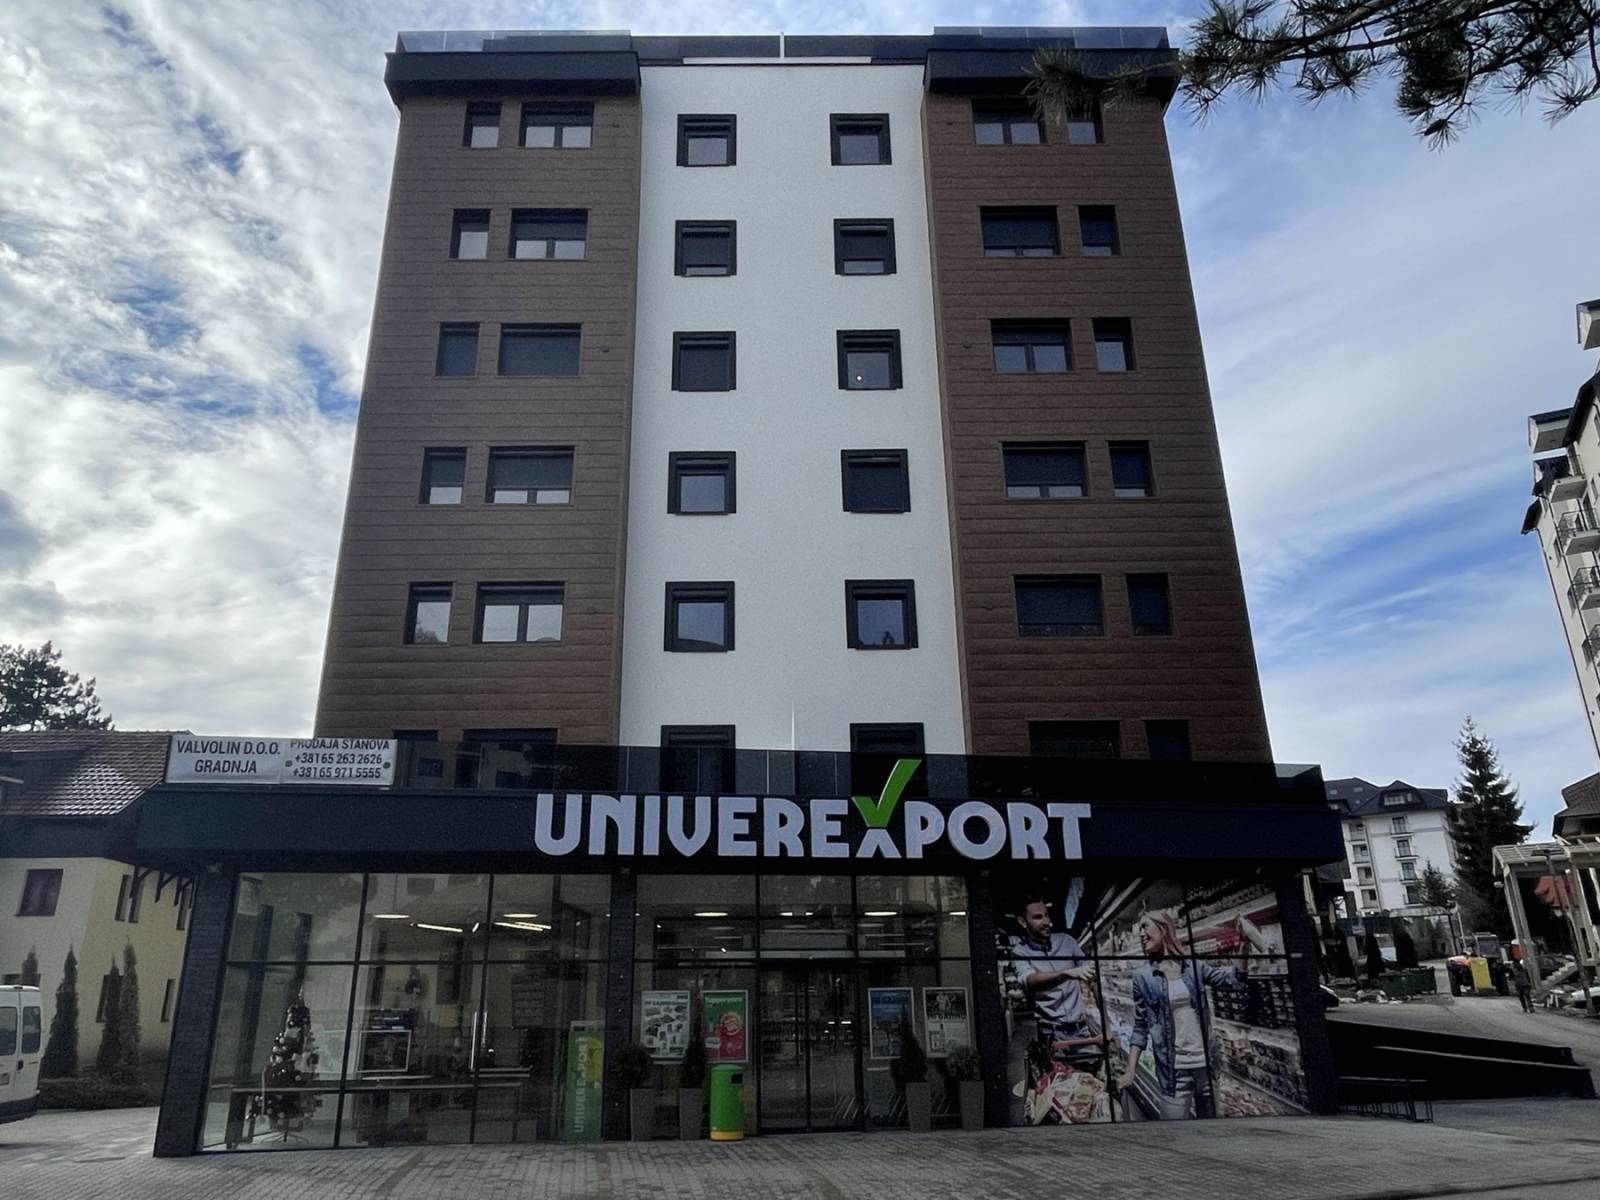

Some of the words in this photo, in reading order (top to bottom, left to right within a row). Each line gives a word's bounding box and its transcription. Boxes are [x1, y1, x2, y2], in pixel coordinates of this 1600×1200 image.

[177, 740, 241, 755] VALVOLIN
[243, 742, 281, 755] D.O.O.
[290, 739, 340, 750] PRODAJA
[342, 739, 390, 751] STANOVA
[194, 758, 257, 774] GRADNJA
[295, 752, 320, 765] +381
[336, 753, 356, 766] 263
[357, 754, 383, 766] 2626
[293, 767, 318, 779] +381
[335, 767, 353, 780] 971
[355, 768, 382, 780] 5555
[534, 759, 1093, 860] UNIVEREXPORT
